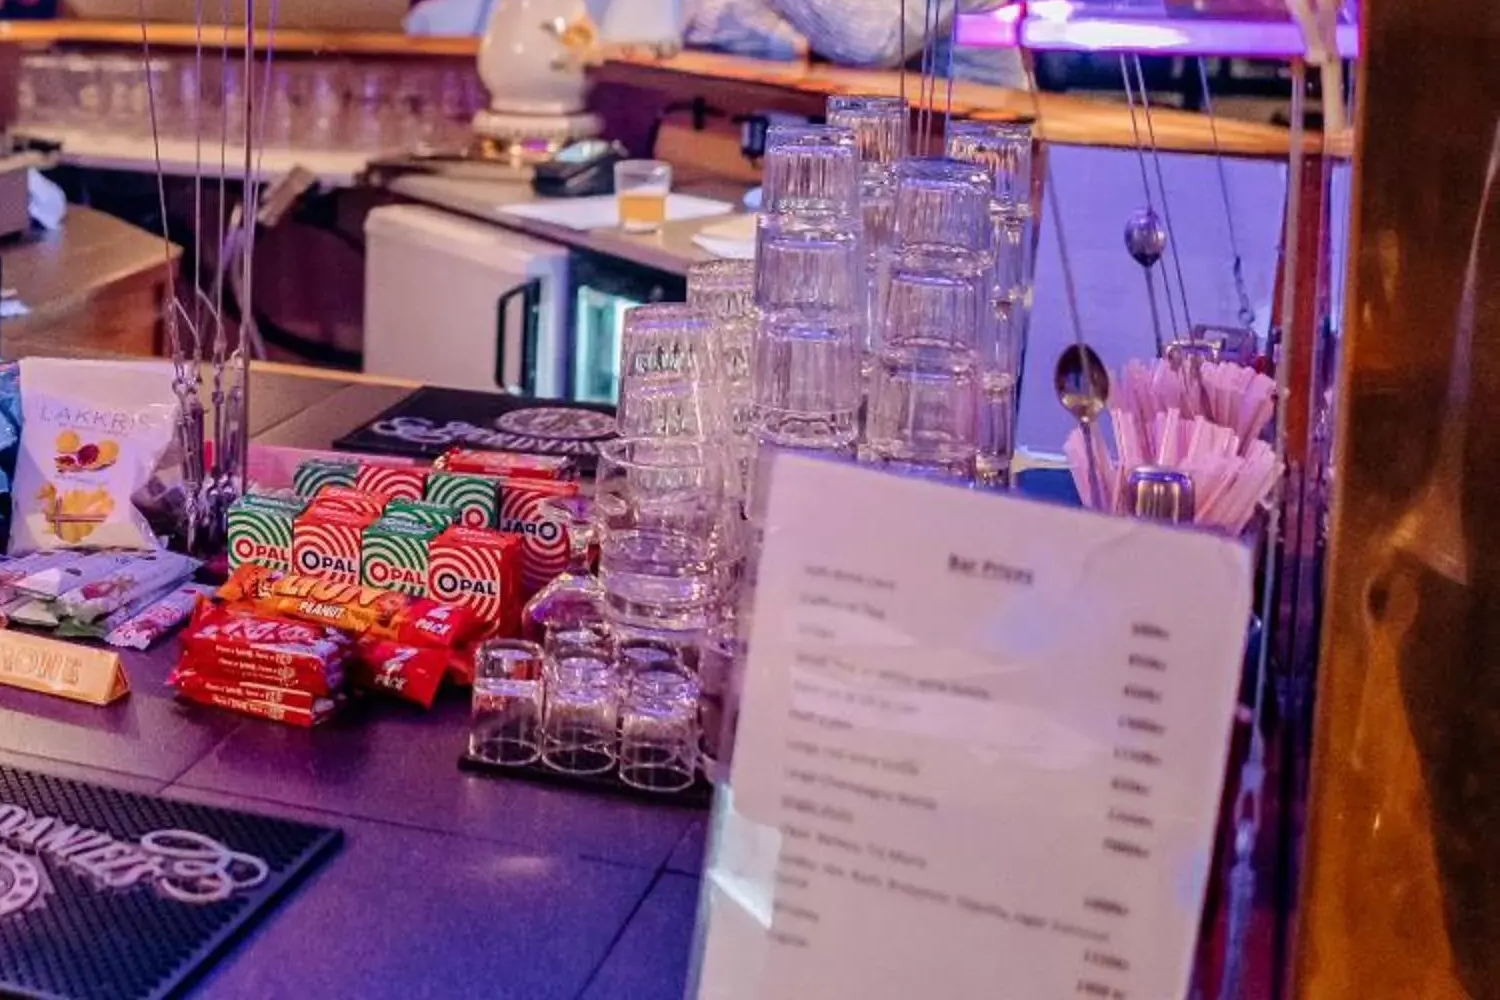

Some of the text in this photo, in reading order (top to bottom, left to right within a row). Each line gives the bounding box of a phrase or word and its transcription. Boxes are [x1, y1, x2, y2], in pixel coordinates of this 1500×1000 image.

[40, 407, 150, 429] LAKKRIS
[235, 538, 289, 561] OPAL
[302, 550, 356, 574] OPAL
[370, 561, 426, 585] OPAL
[438, 573, 496, 596] OPAL
[299, 601, 345, 619] PEANUT
